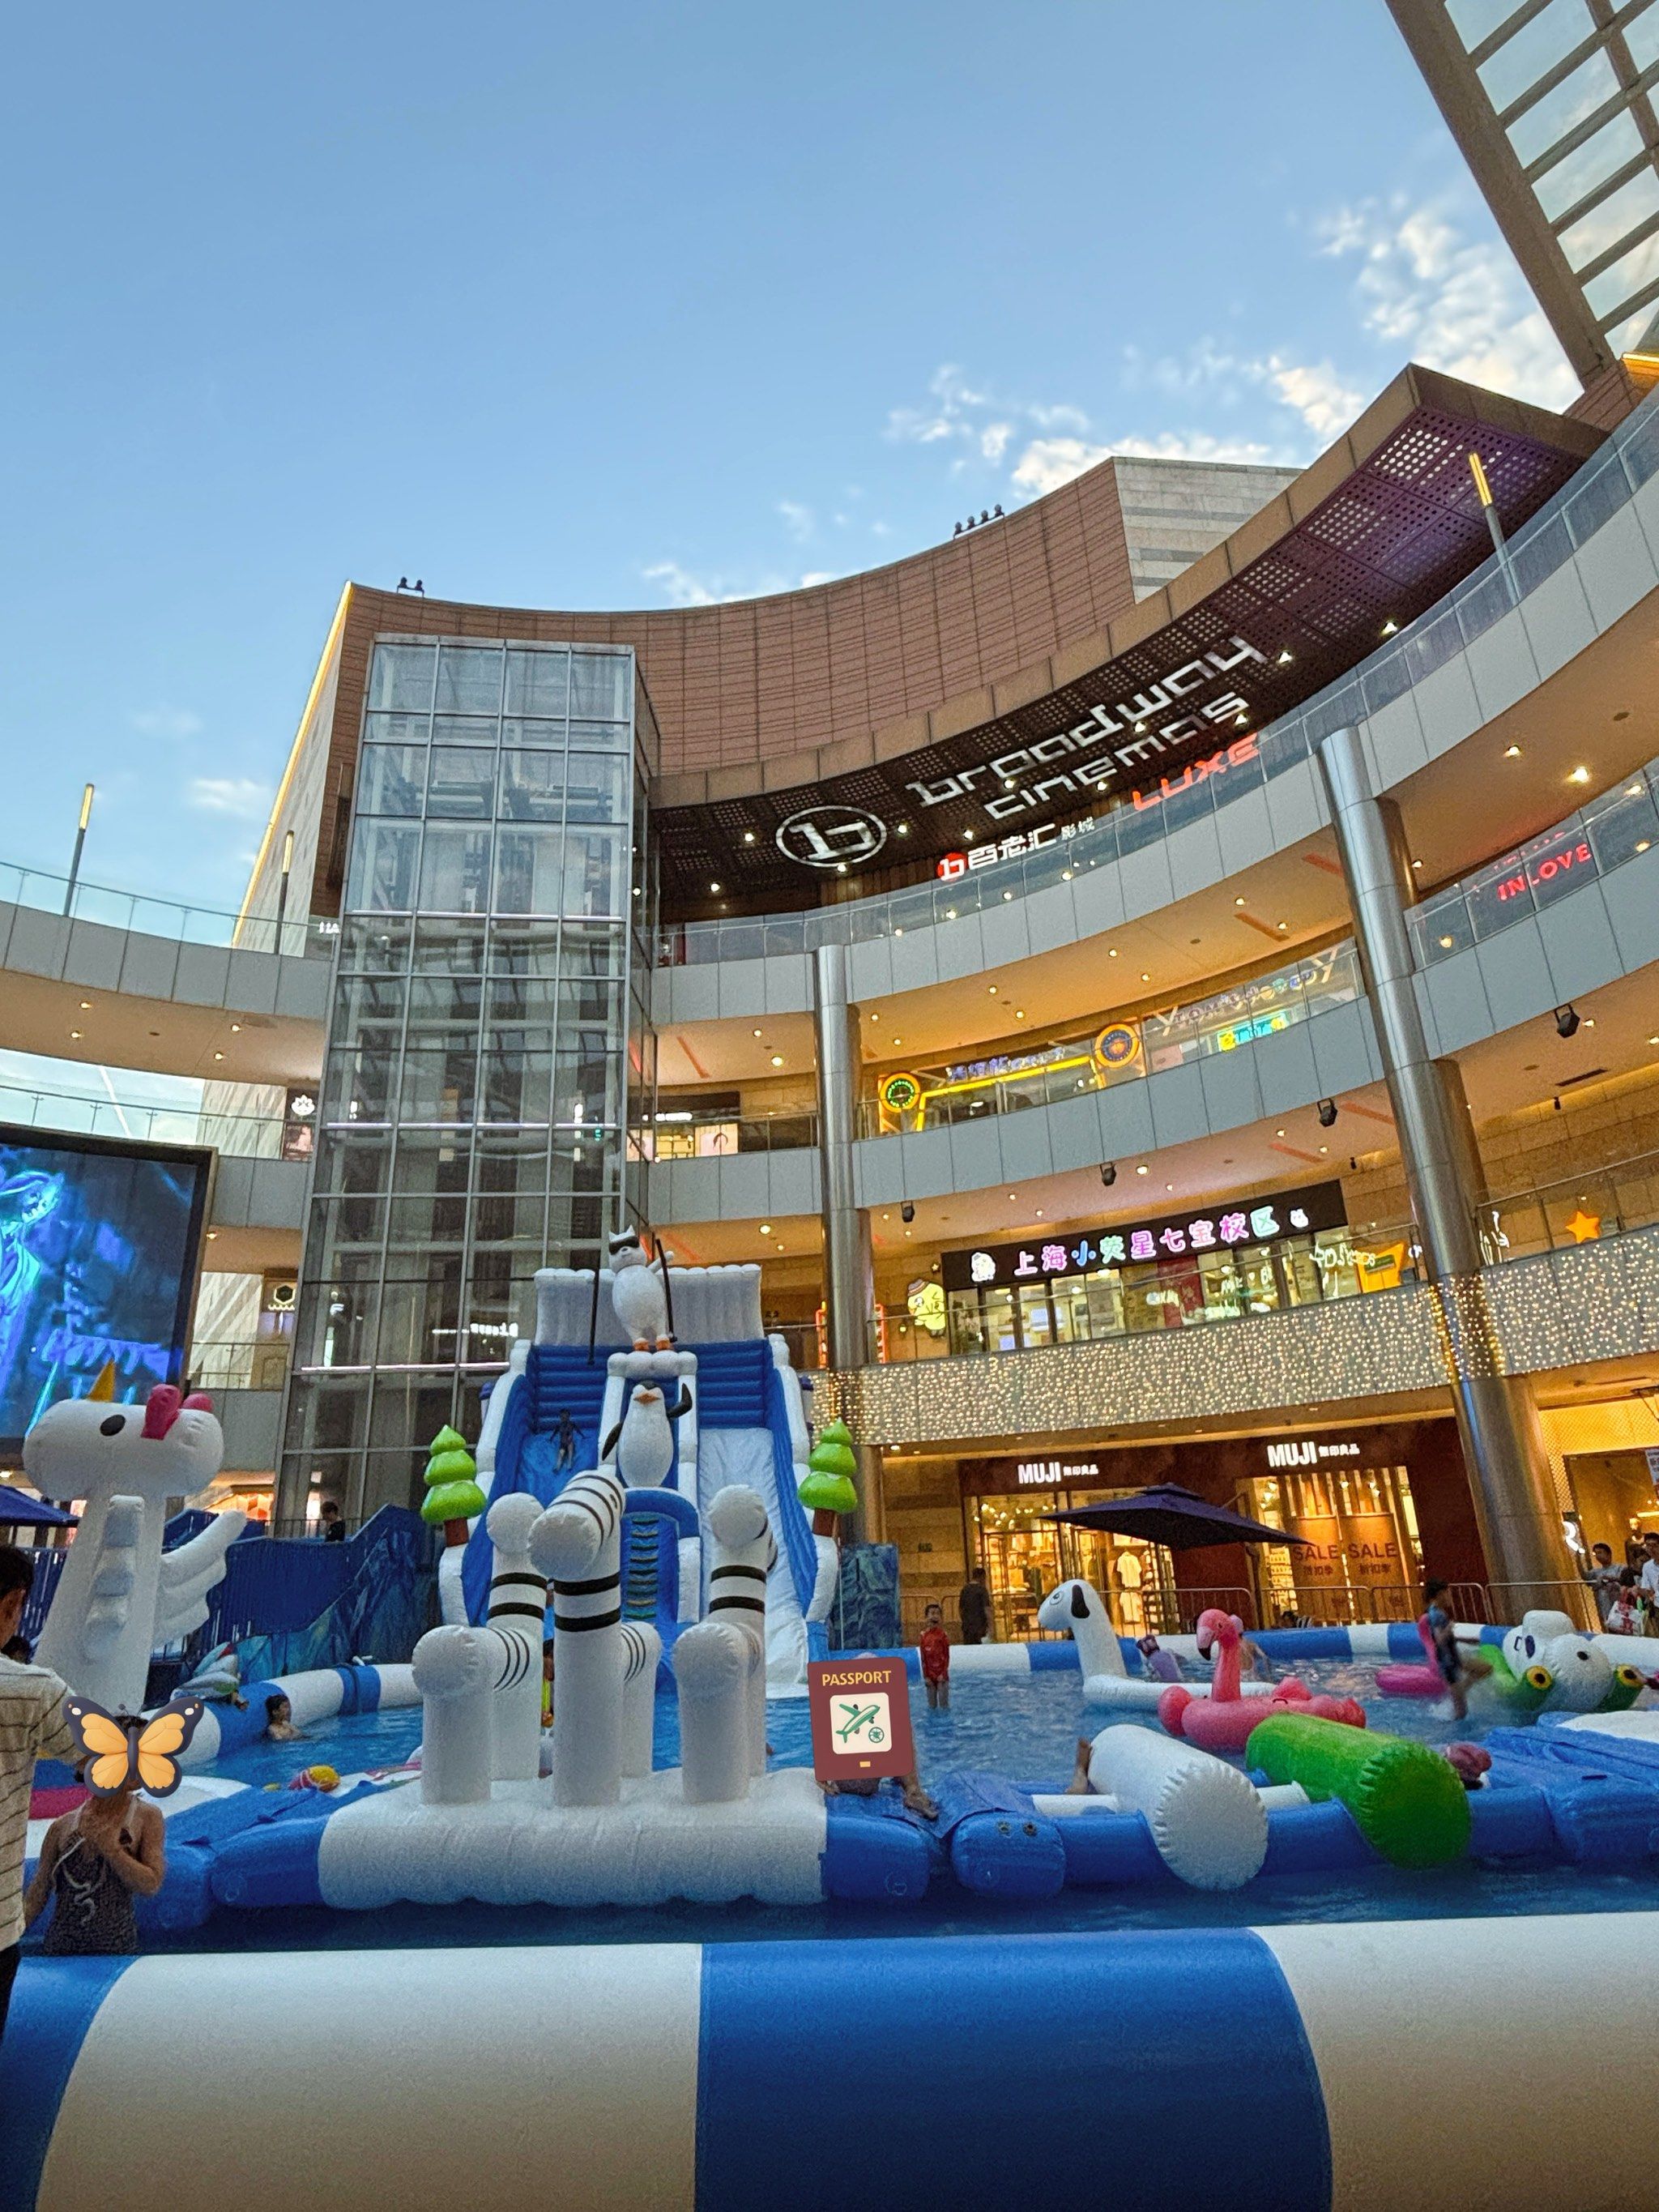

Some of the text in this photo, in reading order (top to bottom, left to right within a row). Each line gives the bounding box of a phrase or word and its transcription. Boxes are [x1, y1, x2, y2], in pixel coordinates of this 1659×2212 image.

[905, 634, 1269, 808] broadway
[983, 691, 1250, 821] cinemas
[1132, 732, 1260, 811] LUXE
[967, 823, 1057, 870] 百老汇
[1013, 1206, 1281, 1277] 上海小荧星七宝校区
[1017, 1461, 1062, 1484] MUJI
[1266, 1441, 1318, 1468] MUJI
[1292, 1544, 1340, 1561] SALE
[1347, 1542, 1398, 1559] SALE
